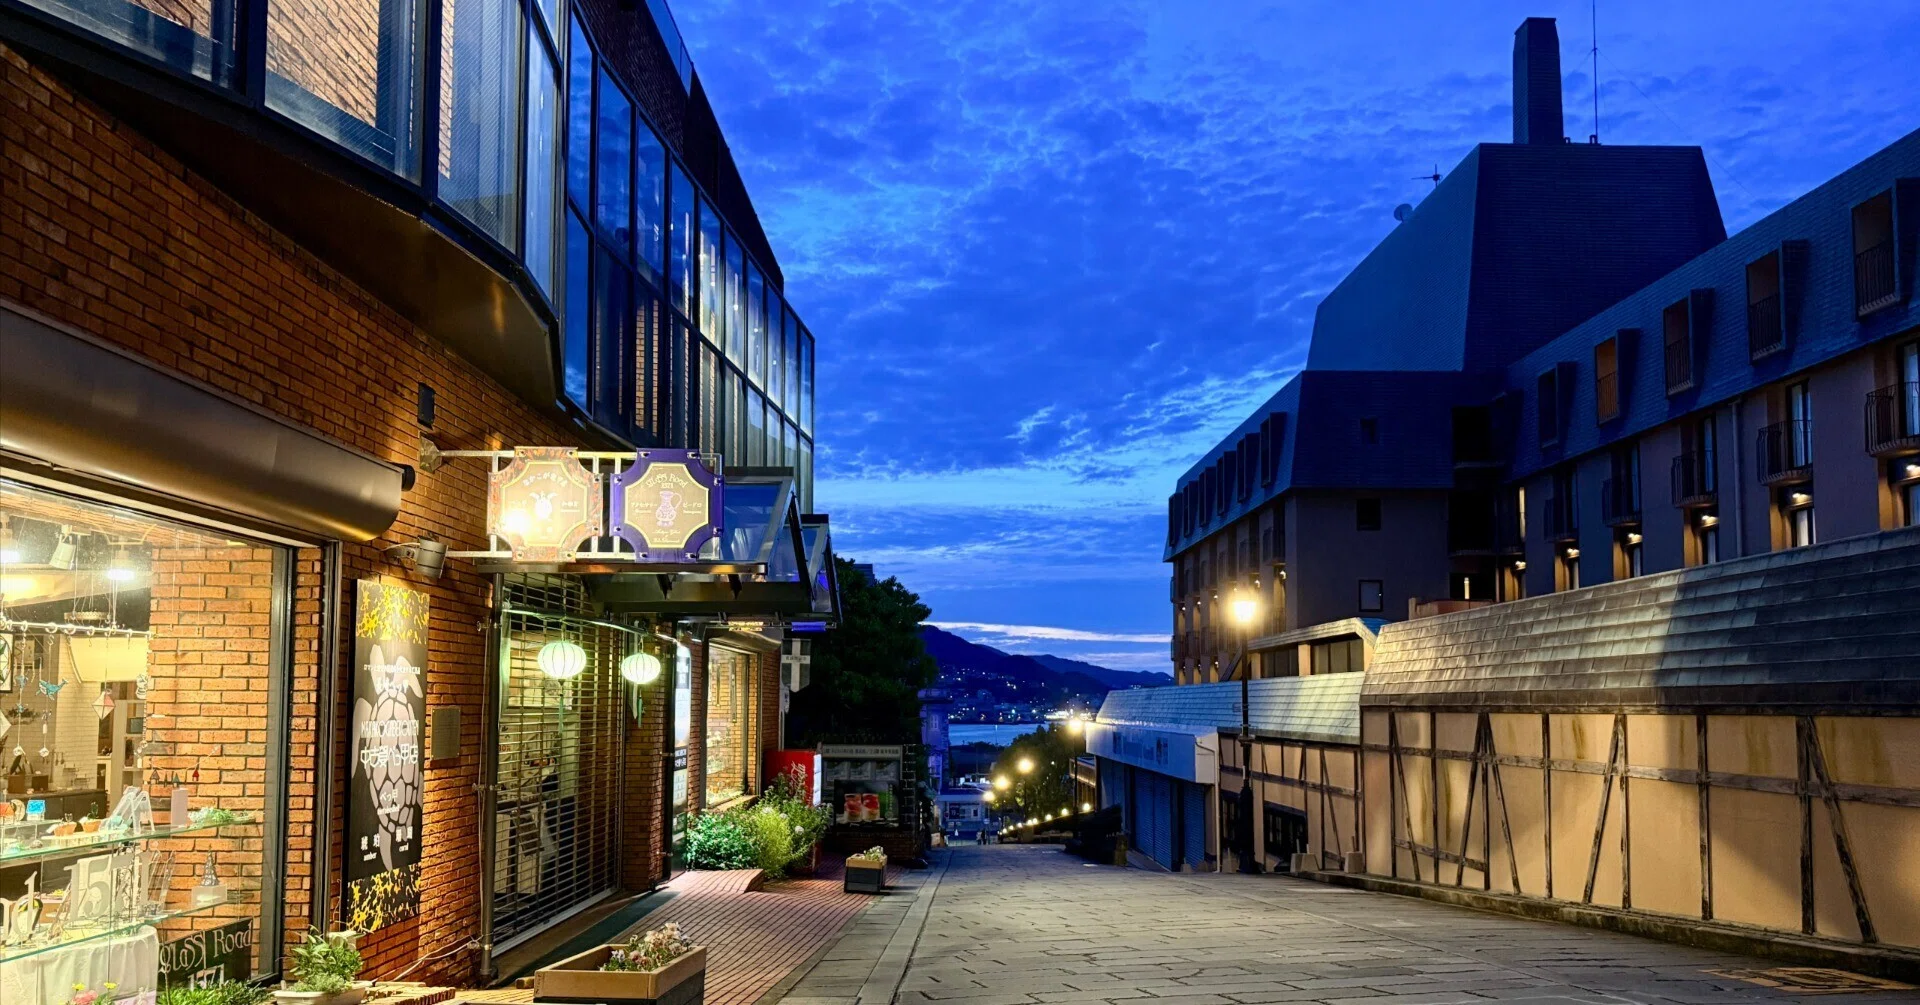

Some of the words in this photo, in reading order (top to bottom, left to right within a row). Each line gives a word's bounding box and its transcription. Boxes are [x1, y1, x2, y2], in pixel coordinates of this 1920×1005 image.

[669, 473, 689, 488] Road
[360, 743, 419, 769] 中古賀べっ甲店
[213, 919, 253, 958] Road
